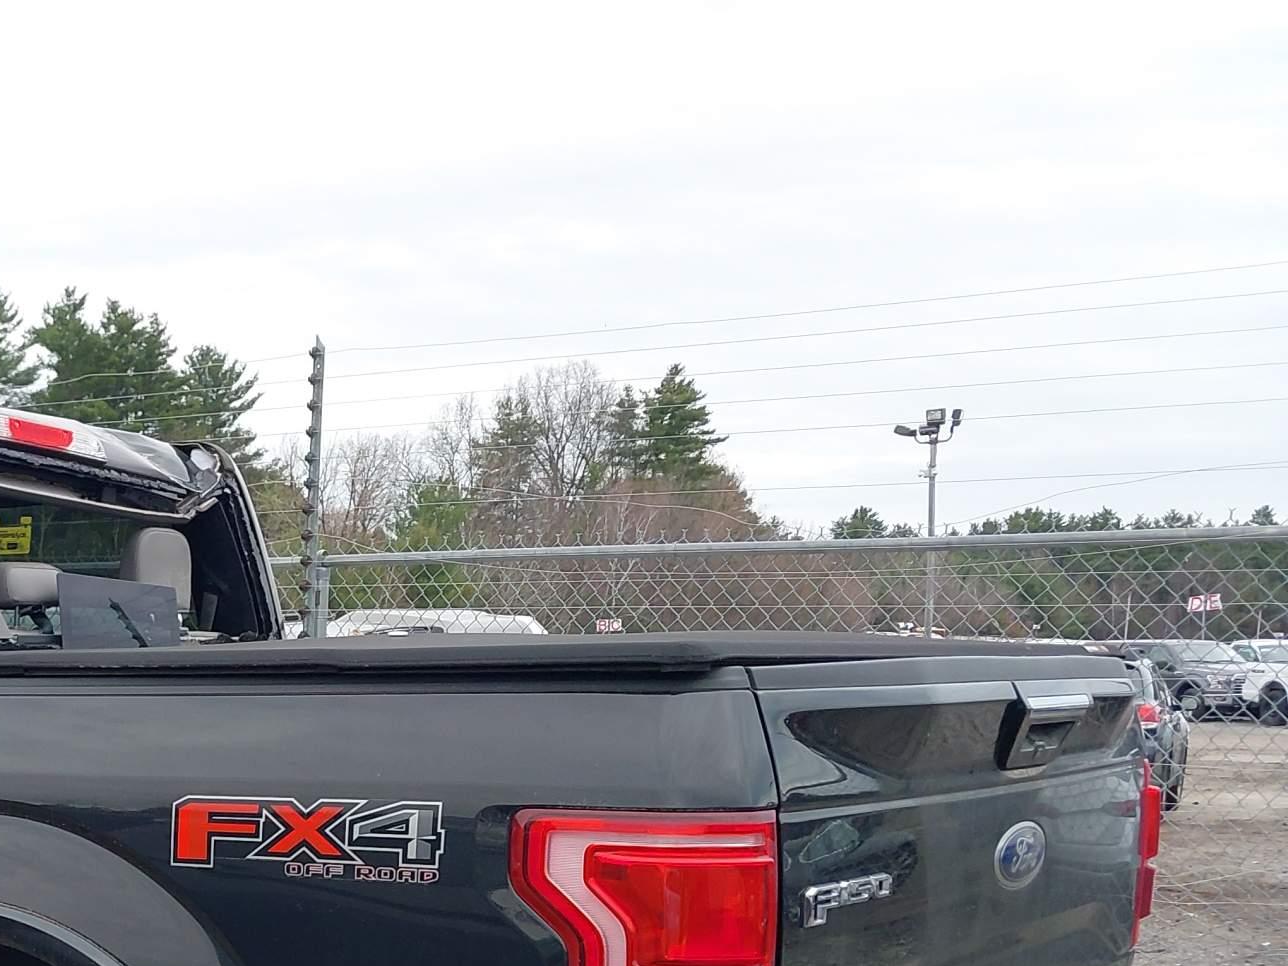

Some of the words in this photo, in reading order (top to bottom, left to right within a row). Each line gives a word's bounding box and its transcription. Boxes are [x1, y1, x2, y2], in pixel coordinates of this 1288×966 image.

[170, 795, 445, 868] FX4
[284, 863, 344, 879] OFF
[354, 865, 440, 884] ROAD
